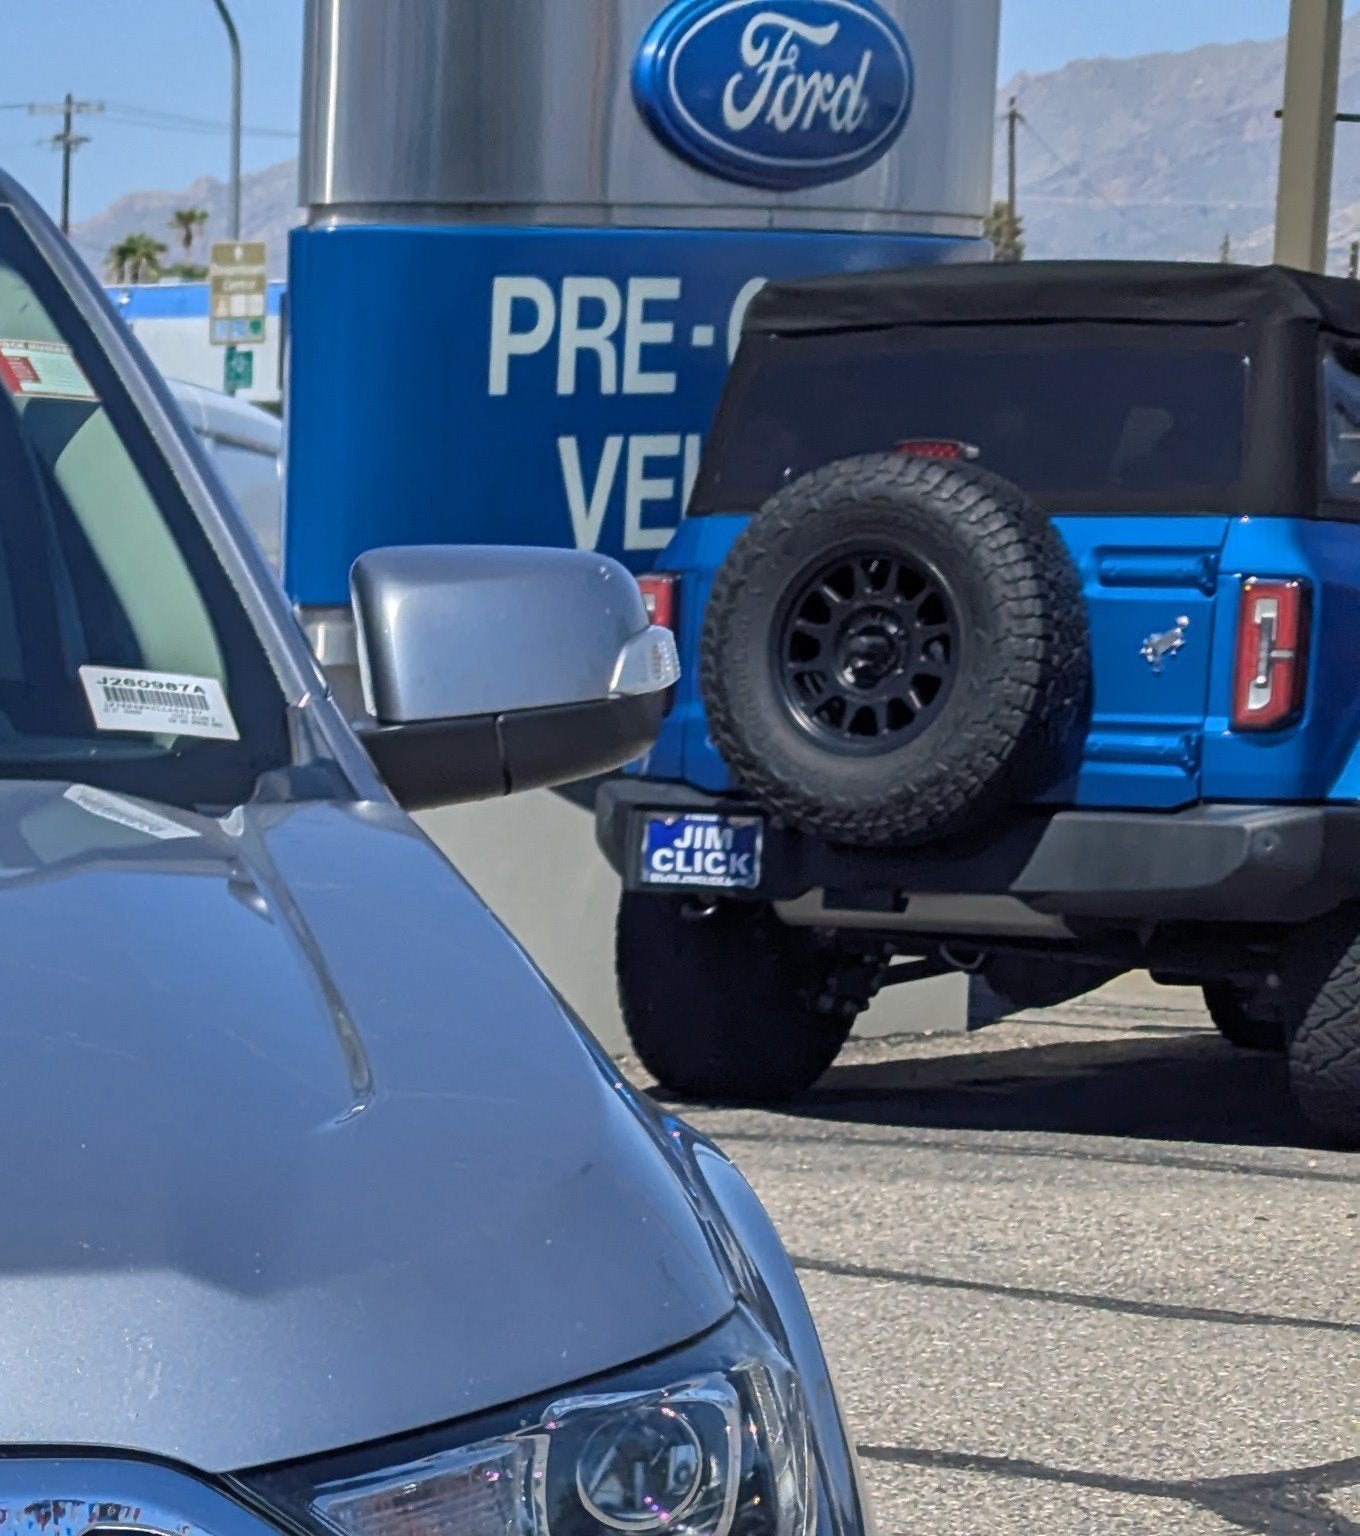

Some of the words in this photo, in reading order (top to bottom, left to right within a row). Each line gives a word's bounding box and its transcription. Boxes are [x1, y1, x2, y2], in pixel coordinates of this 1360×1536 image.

[723, 12, 871, 134] Ford
[487, 276, 768, 396] PRE-
[556, 433, 701, 551] VE
[651, 847, 751, 875] CLICK
[673, 824, 734, 851] JIM
